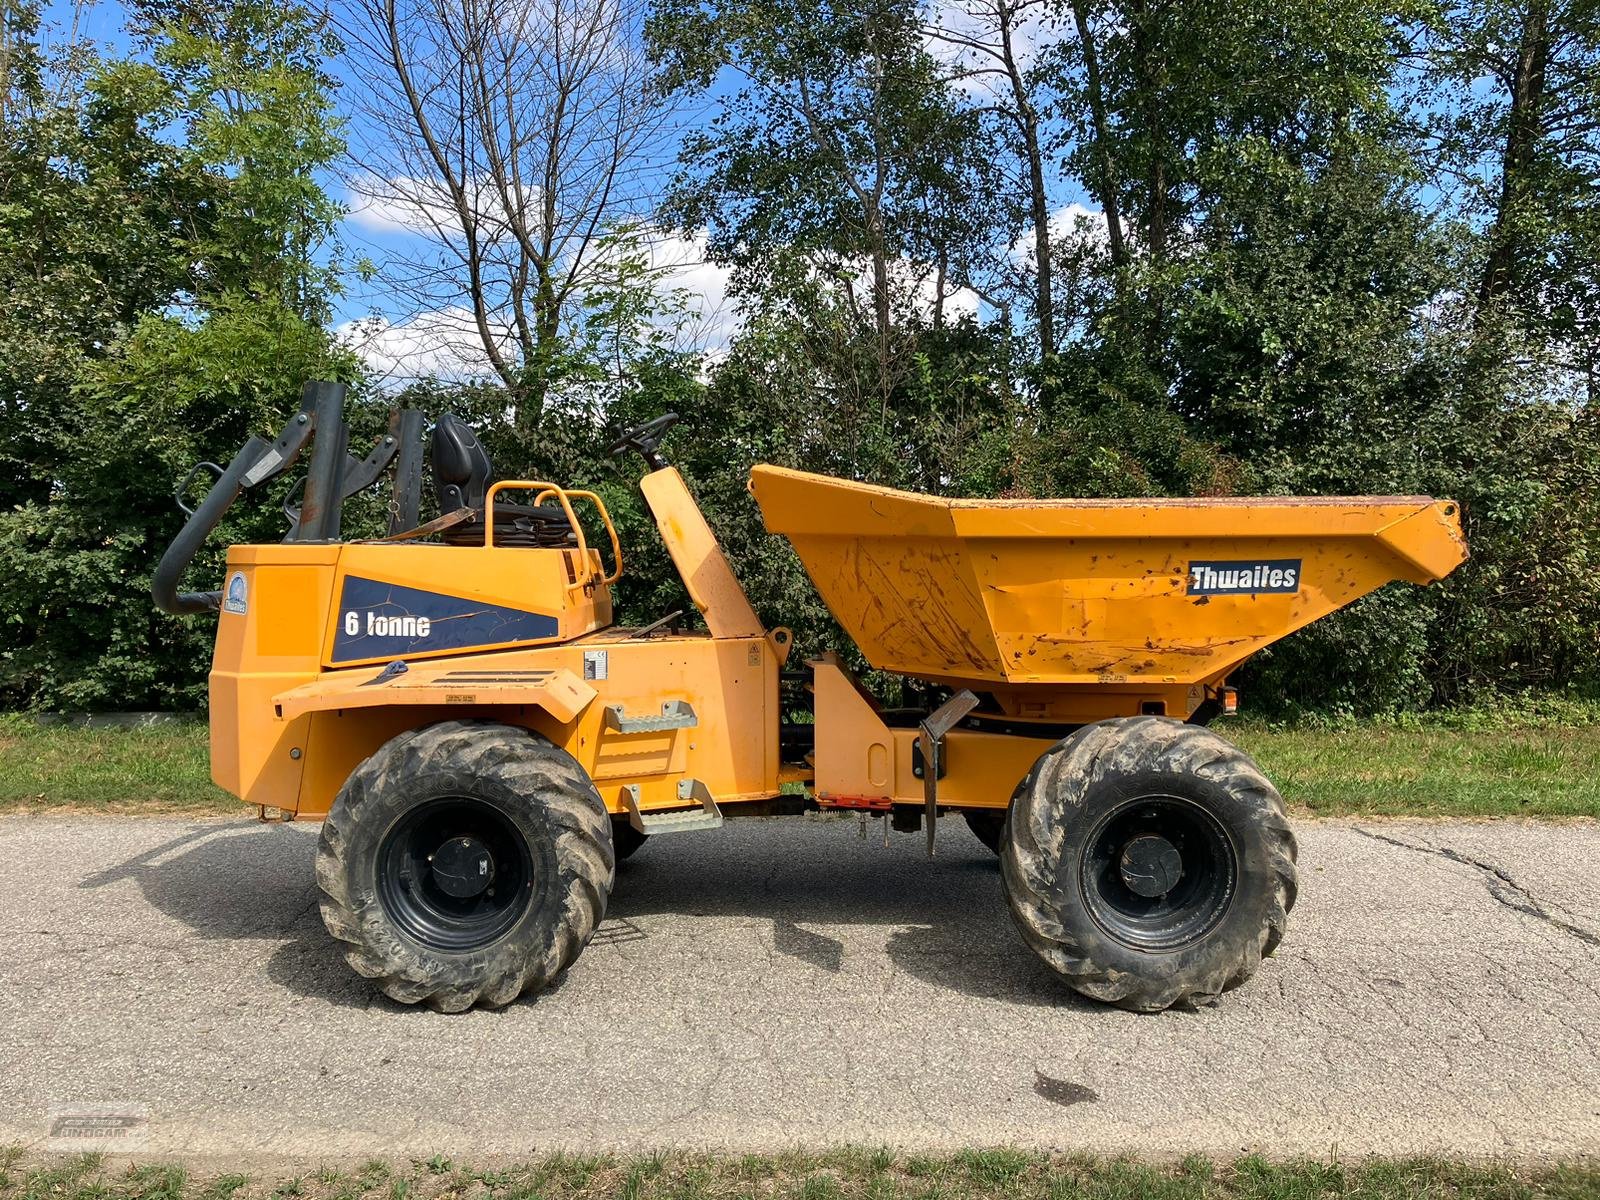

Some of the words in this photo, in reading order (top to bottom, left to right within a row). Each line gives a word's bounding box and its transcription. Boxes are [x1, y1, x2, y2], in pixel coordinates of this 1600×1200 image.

[1191, 565, 1297, 590] Thwaites
[345, 611, 359, 636] 6
[367, 611, 430, 637] tonne
